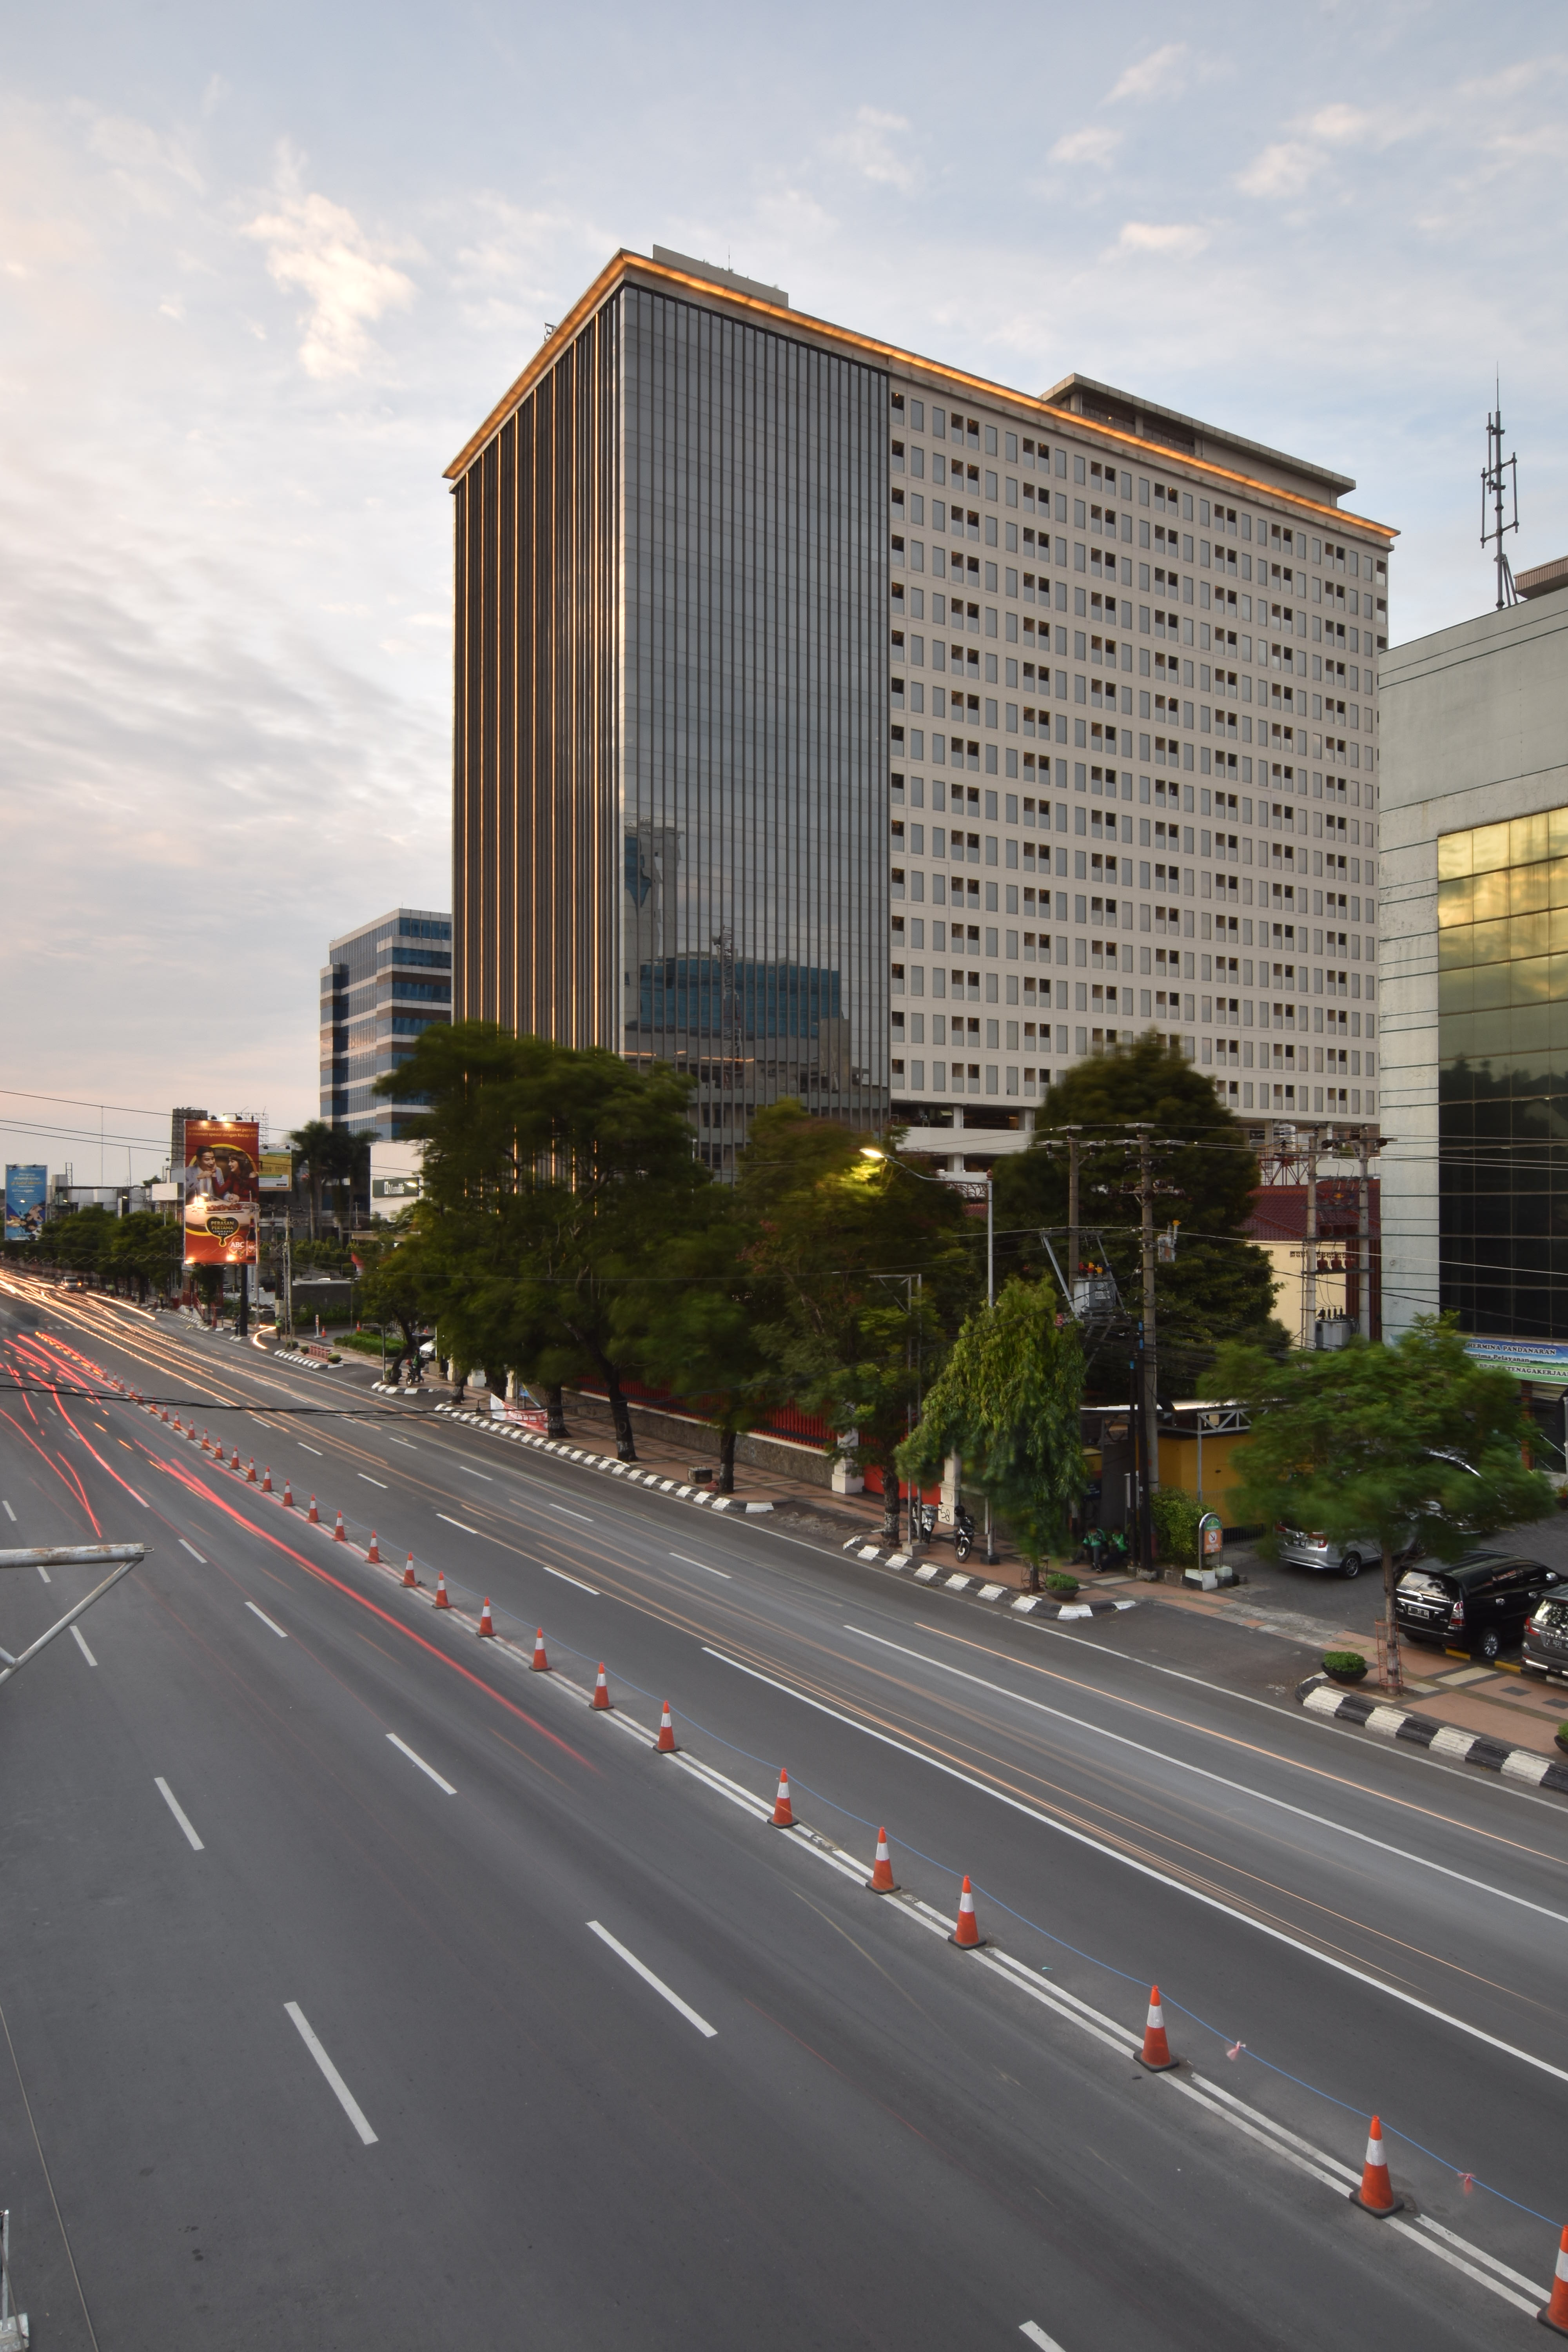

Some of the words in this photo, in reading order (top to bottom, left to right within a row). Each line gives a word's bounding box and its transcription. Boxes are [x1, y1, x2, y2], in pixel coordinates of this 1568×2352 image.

[1503, 1346, 1556, 1355] PANDANARAN
[1493, 1354, 1530, 1363] Pelayanan
[941, 1505, 950, 1522] 58
